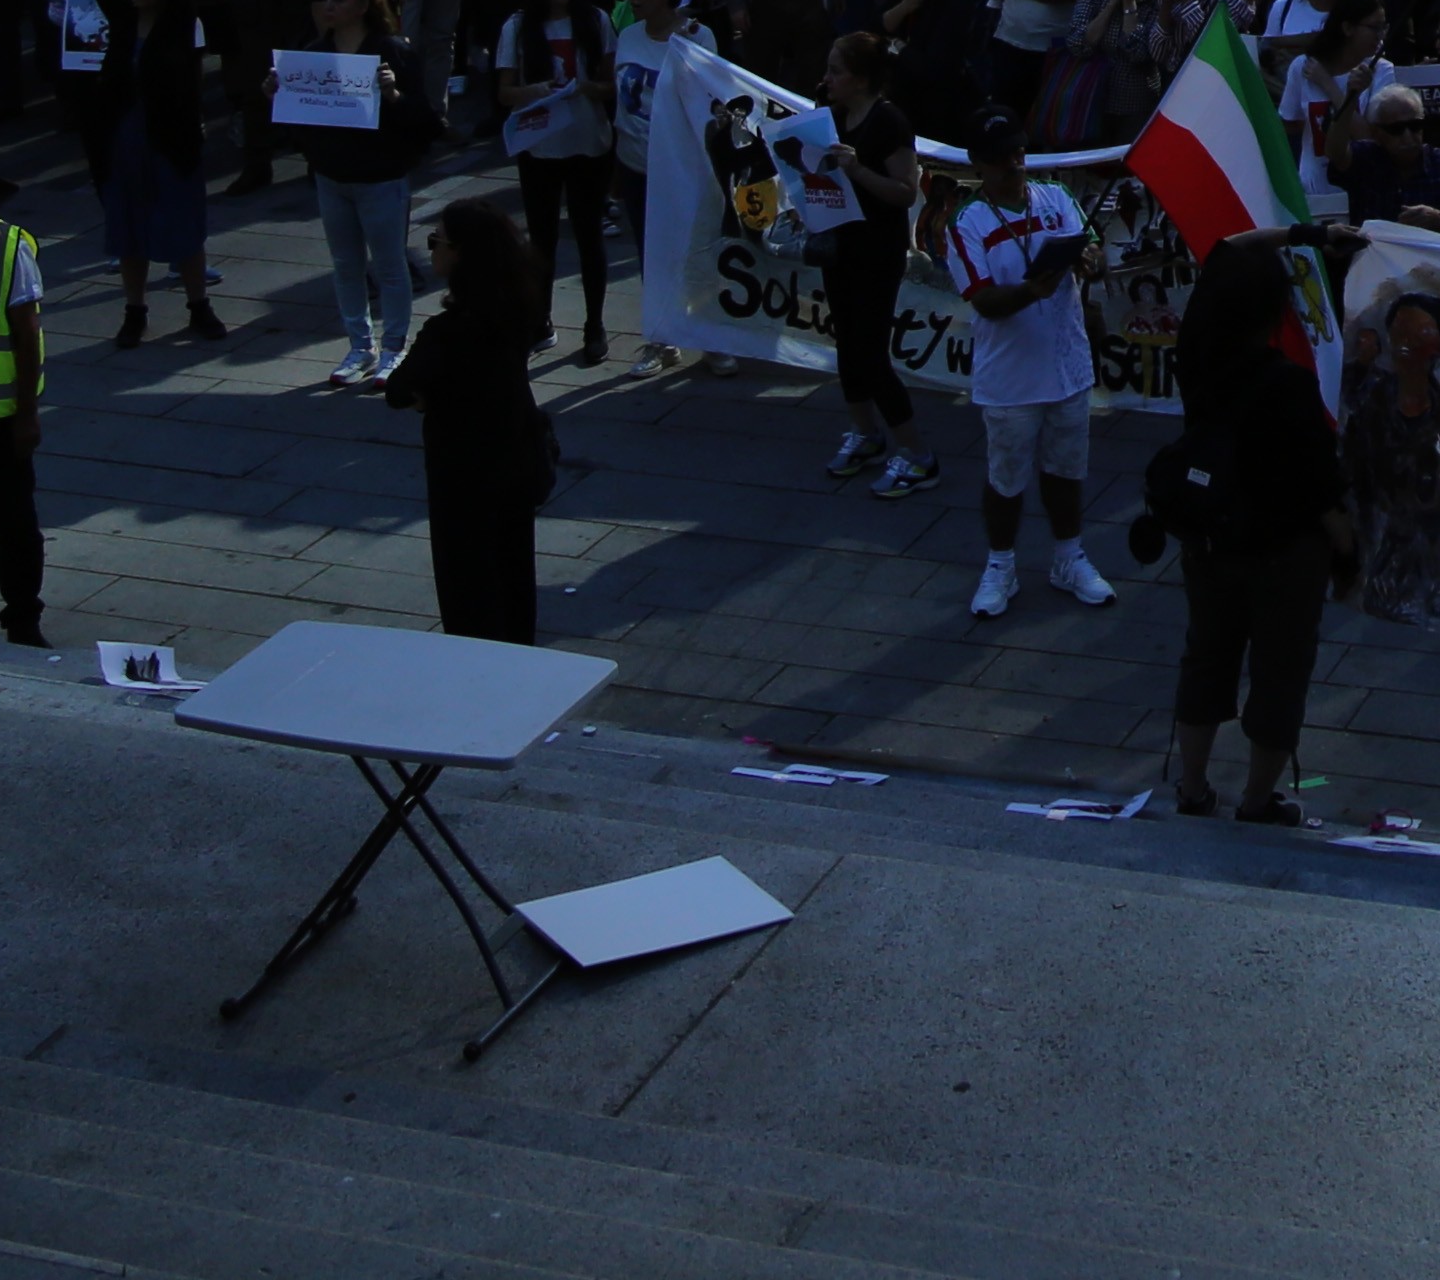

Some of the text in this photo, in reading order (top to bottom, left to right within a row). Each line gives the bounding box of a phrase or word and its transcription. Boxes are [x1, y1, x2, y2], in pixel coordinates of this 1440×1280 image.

[805, 189, 844, 198] WE WILL
[805, 197, 846, 206] SURVIVE
